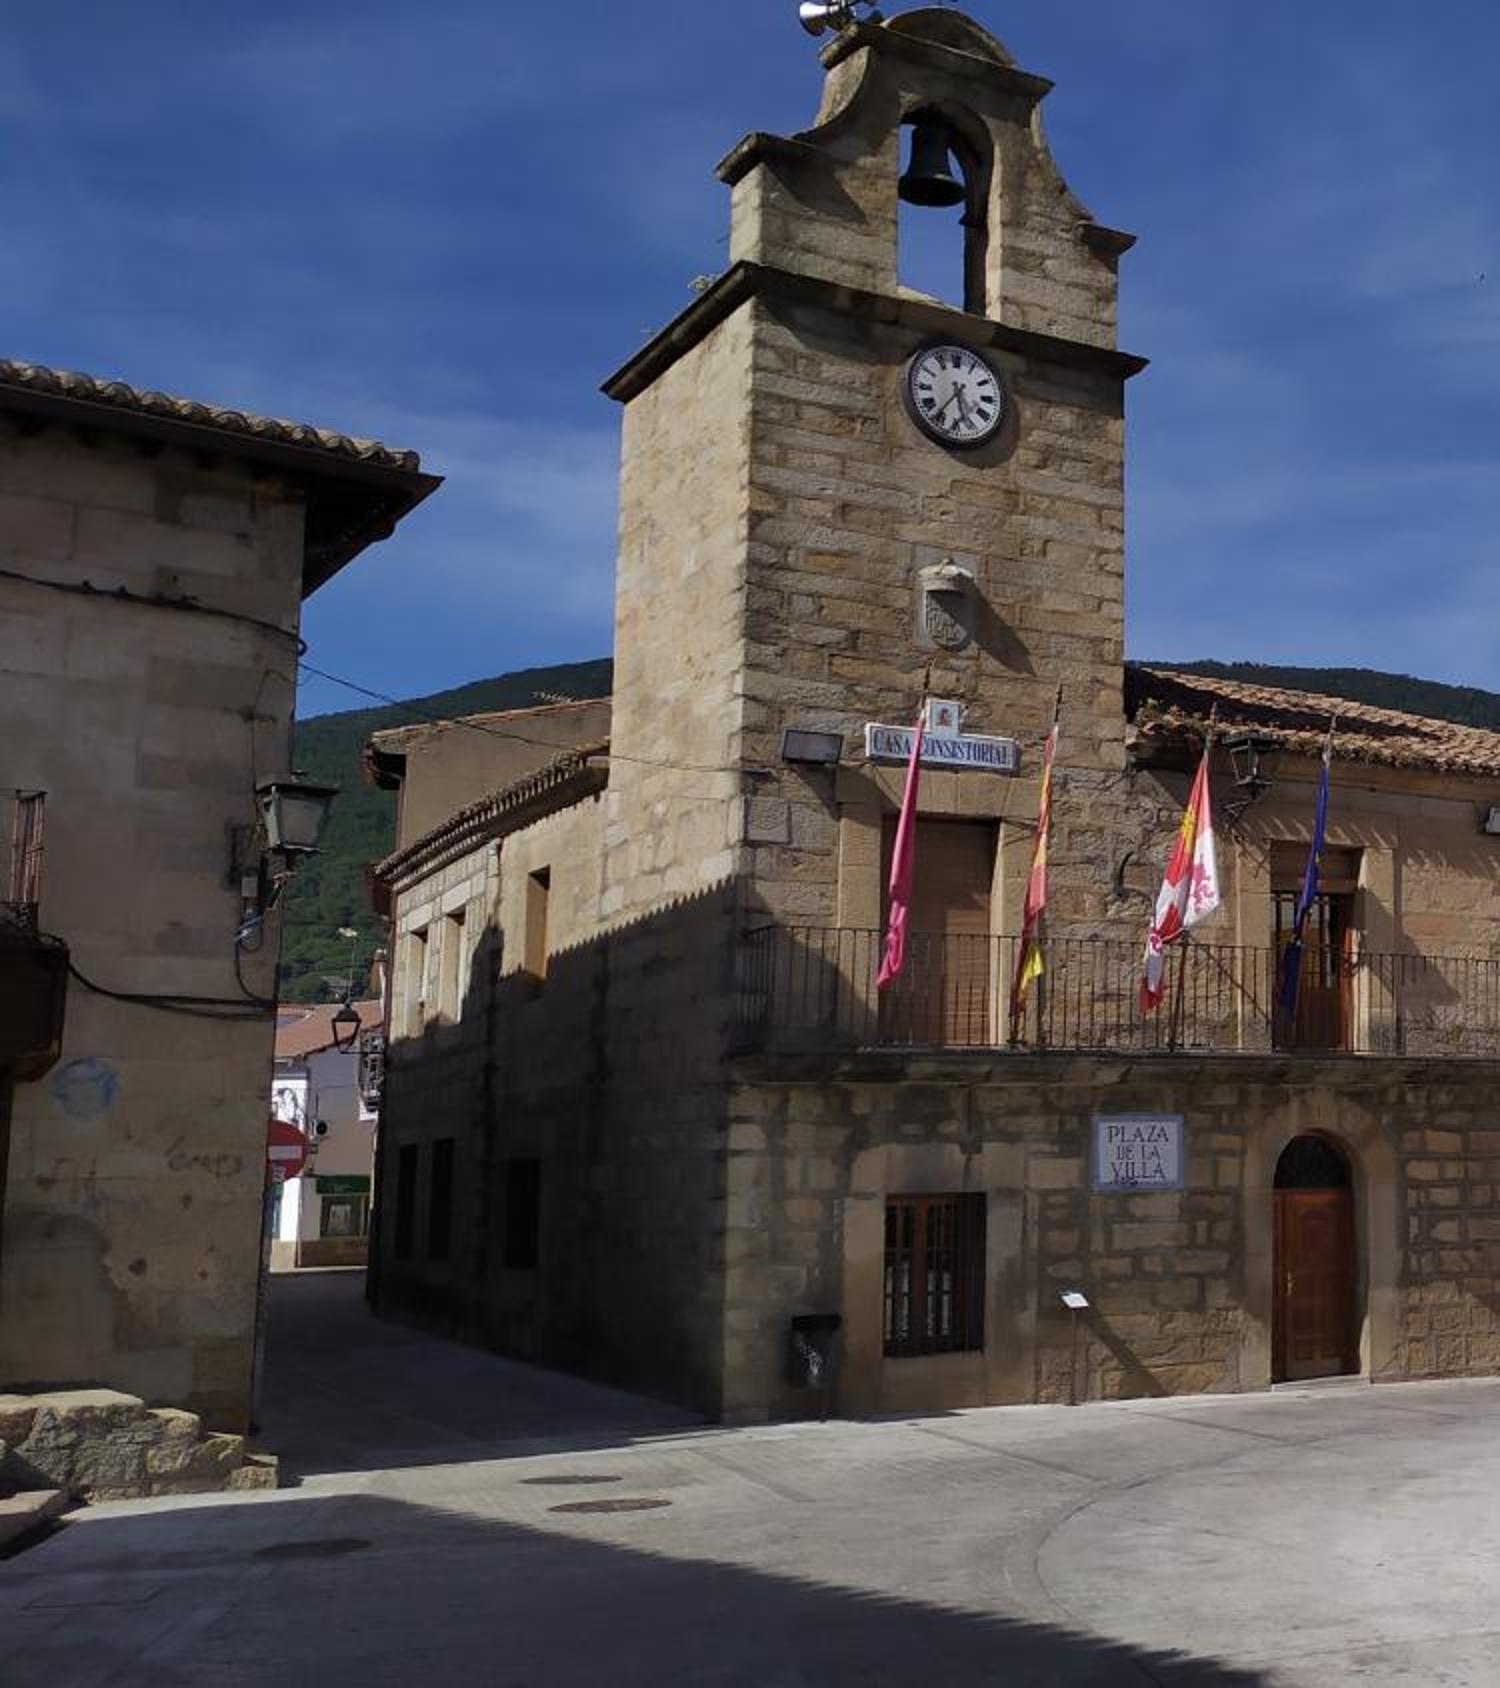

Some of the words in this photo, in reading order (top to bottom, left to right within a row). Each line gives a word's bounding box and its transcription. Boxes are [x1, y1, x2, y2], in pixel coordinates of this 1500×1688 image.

[873, 729, 912, 755] CASA
[1107, 1125, 1169, 1143] PLAZA
[1116, 1144, 1135, 1160] DE
[1141, 1144, 1161, 1160] LA
[1110, 1162, 1167, 1181] VILLA
